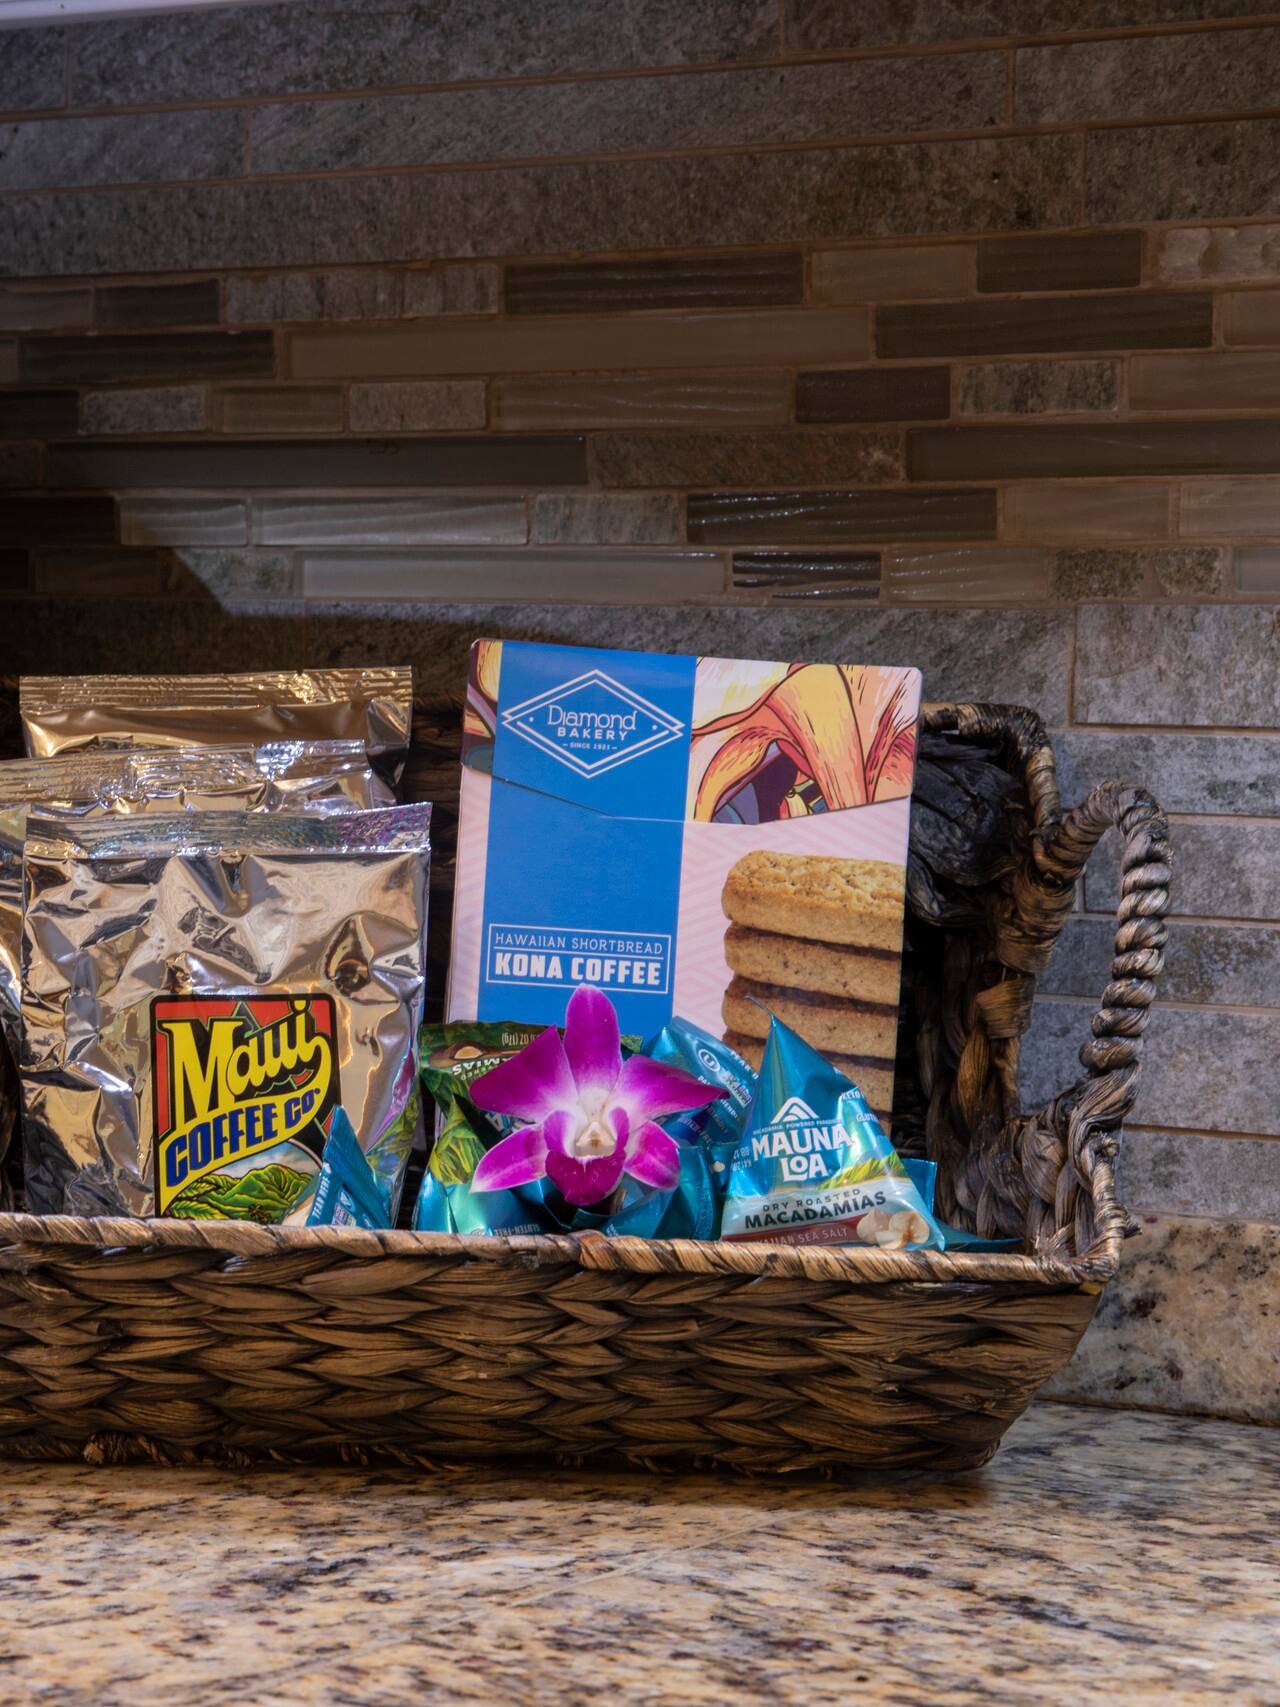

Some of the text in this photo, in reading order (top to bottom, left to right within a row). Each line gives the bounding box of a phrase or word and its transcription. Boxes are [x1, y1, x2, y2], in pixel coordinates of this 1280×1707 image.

[547, 705, 638, 731] Diamond
[557, 727, 628, 741] BAKERY
[570, 742, 590, 750] SINCE
[495, 933, 663, 954] HAWAIIAN SHORTBREAD
[495, 952, 662, 986] KONA COFFEE
[161, 1000, 331, 1131] Maui
[166, 1103, 279, 1188] COFFEE
[751, 1123, 854, 1161] MAUNA
[780, 1153, 829, 1182] LOA
[745, 1191, 887, 1229] MACADAMIAS
[763, 1188, 861, 1213] DRY ROASTED
[799, 1234, 819, 1244] SEA
[821, 1228, 848, 1239] SALT
